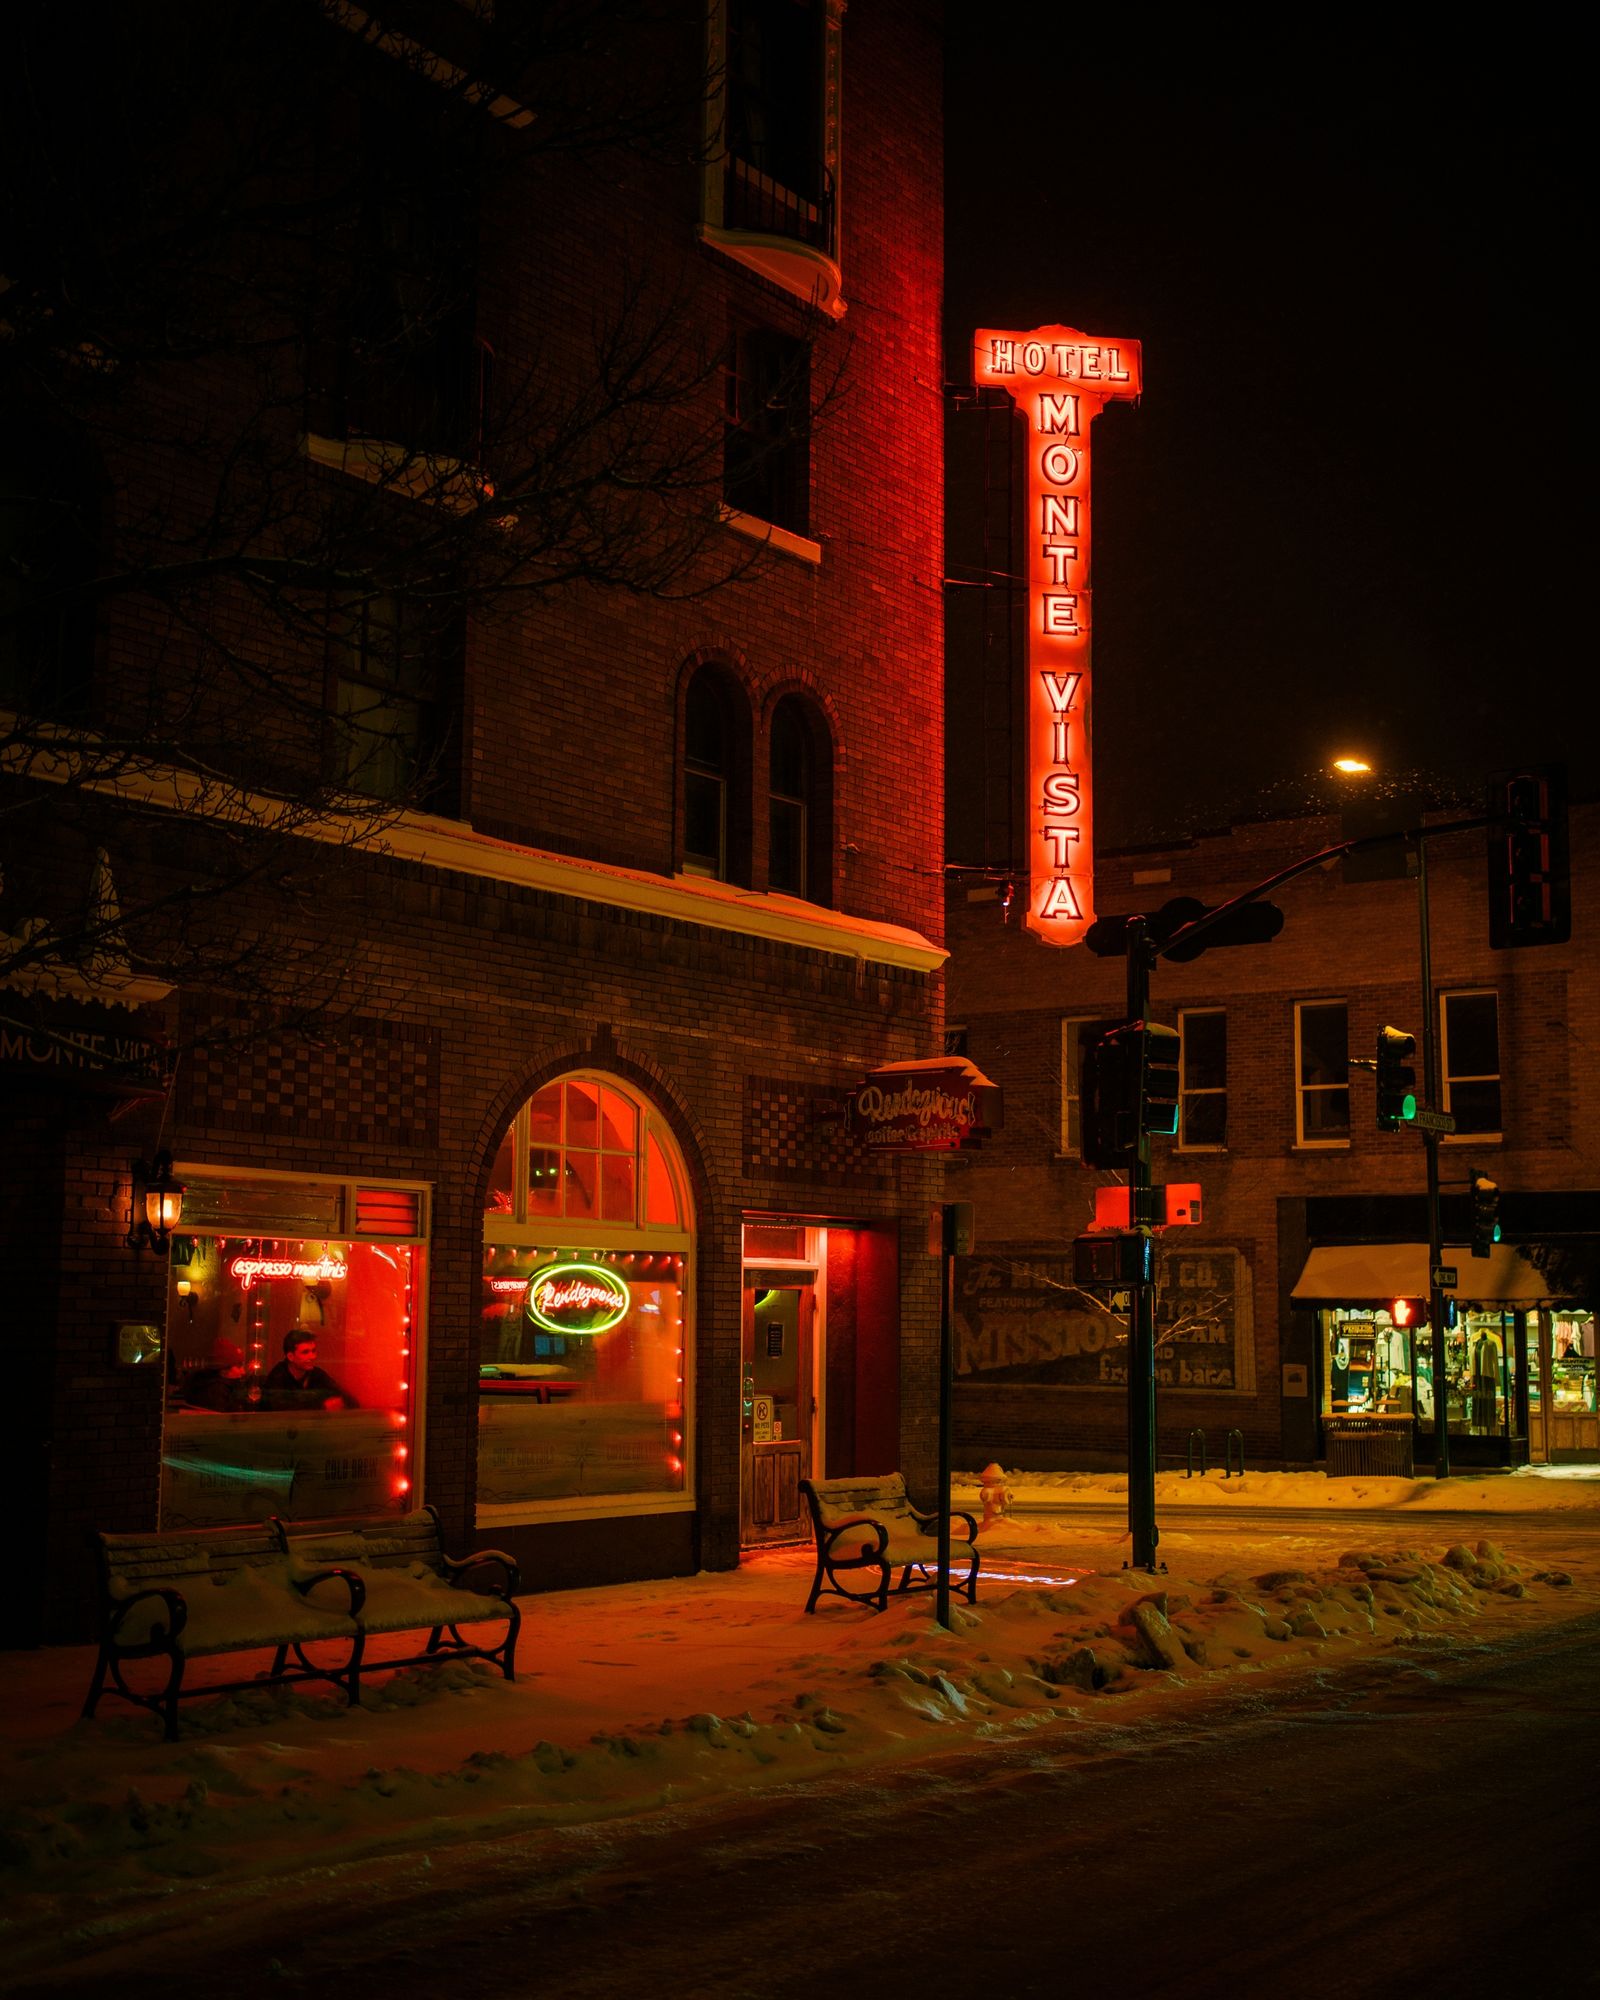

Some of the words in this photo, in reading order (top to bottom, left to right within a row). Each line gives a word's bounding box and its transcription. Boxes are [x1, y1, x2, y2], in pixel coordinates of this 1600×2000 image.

[990, 339, 1129, 381] HOTEL
[1039, 394, 1080, 636] MONTE
[1040, 671, 1083, 920] VISTA
[0, 1029, 105, 1070] MONTE
[233, 1259, 292, 1287] espresso
[293, 1257, 346, 1279] martinis
[541, 1279, 624, 1313] Rendezvous
[1157, 1323, 1227, 1344] REAM
[1154, 1347, 1174, 1360] ND
[1179, 1359, 1233, 1386] bars
